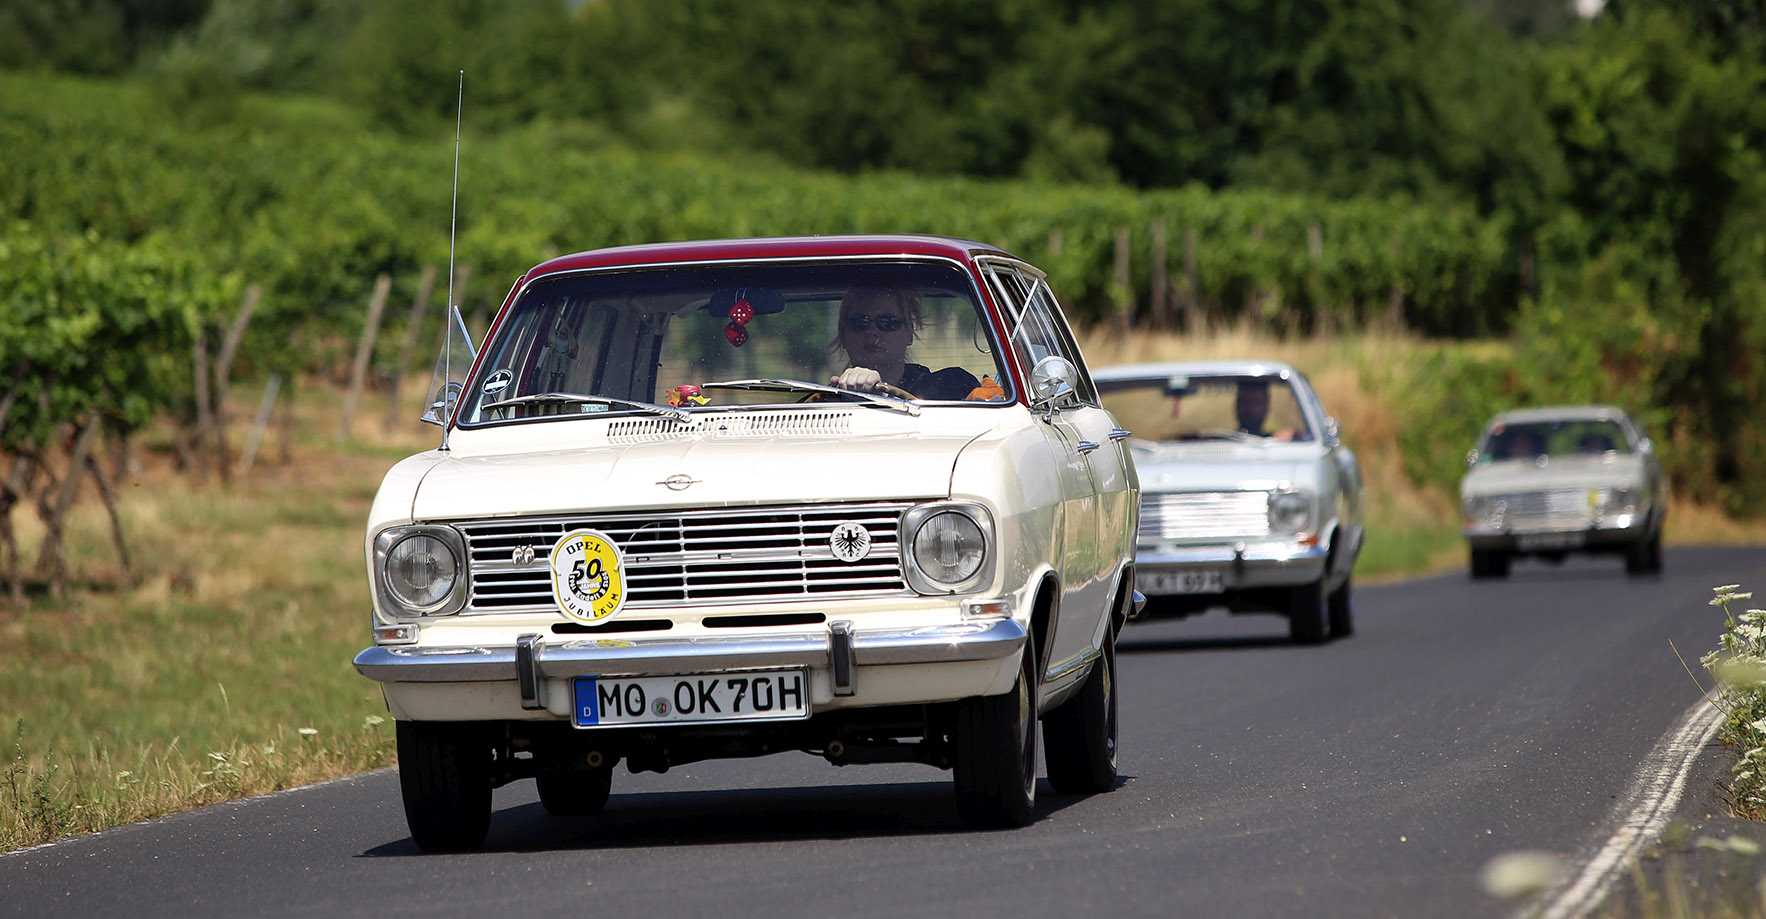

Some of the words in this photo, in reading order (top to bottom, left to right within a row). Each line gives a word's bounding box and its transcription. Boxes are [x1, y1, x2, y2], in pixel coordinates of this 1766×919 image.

[566, 541, 602, 555] OPEL
[572, 558, 602, 580] 50
[564, 593, 618, 618] JUBILÄUM
[583, 706, 591, 717] D
[598, 683, 646, 717] MO
